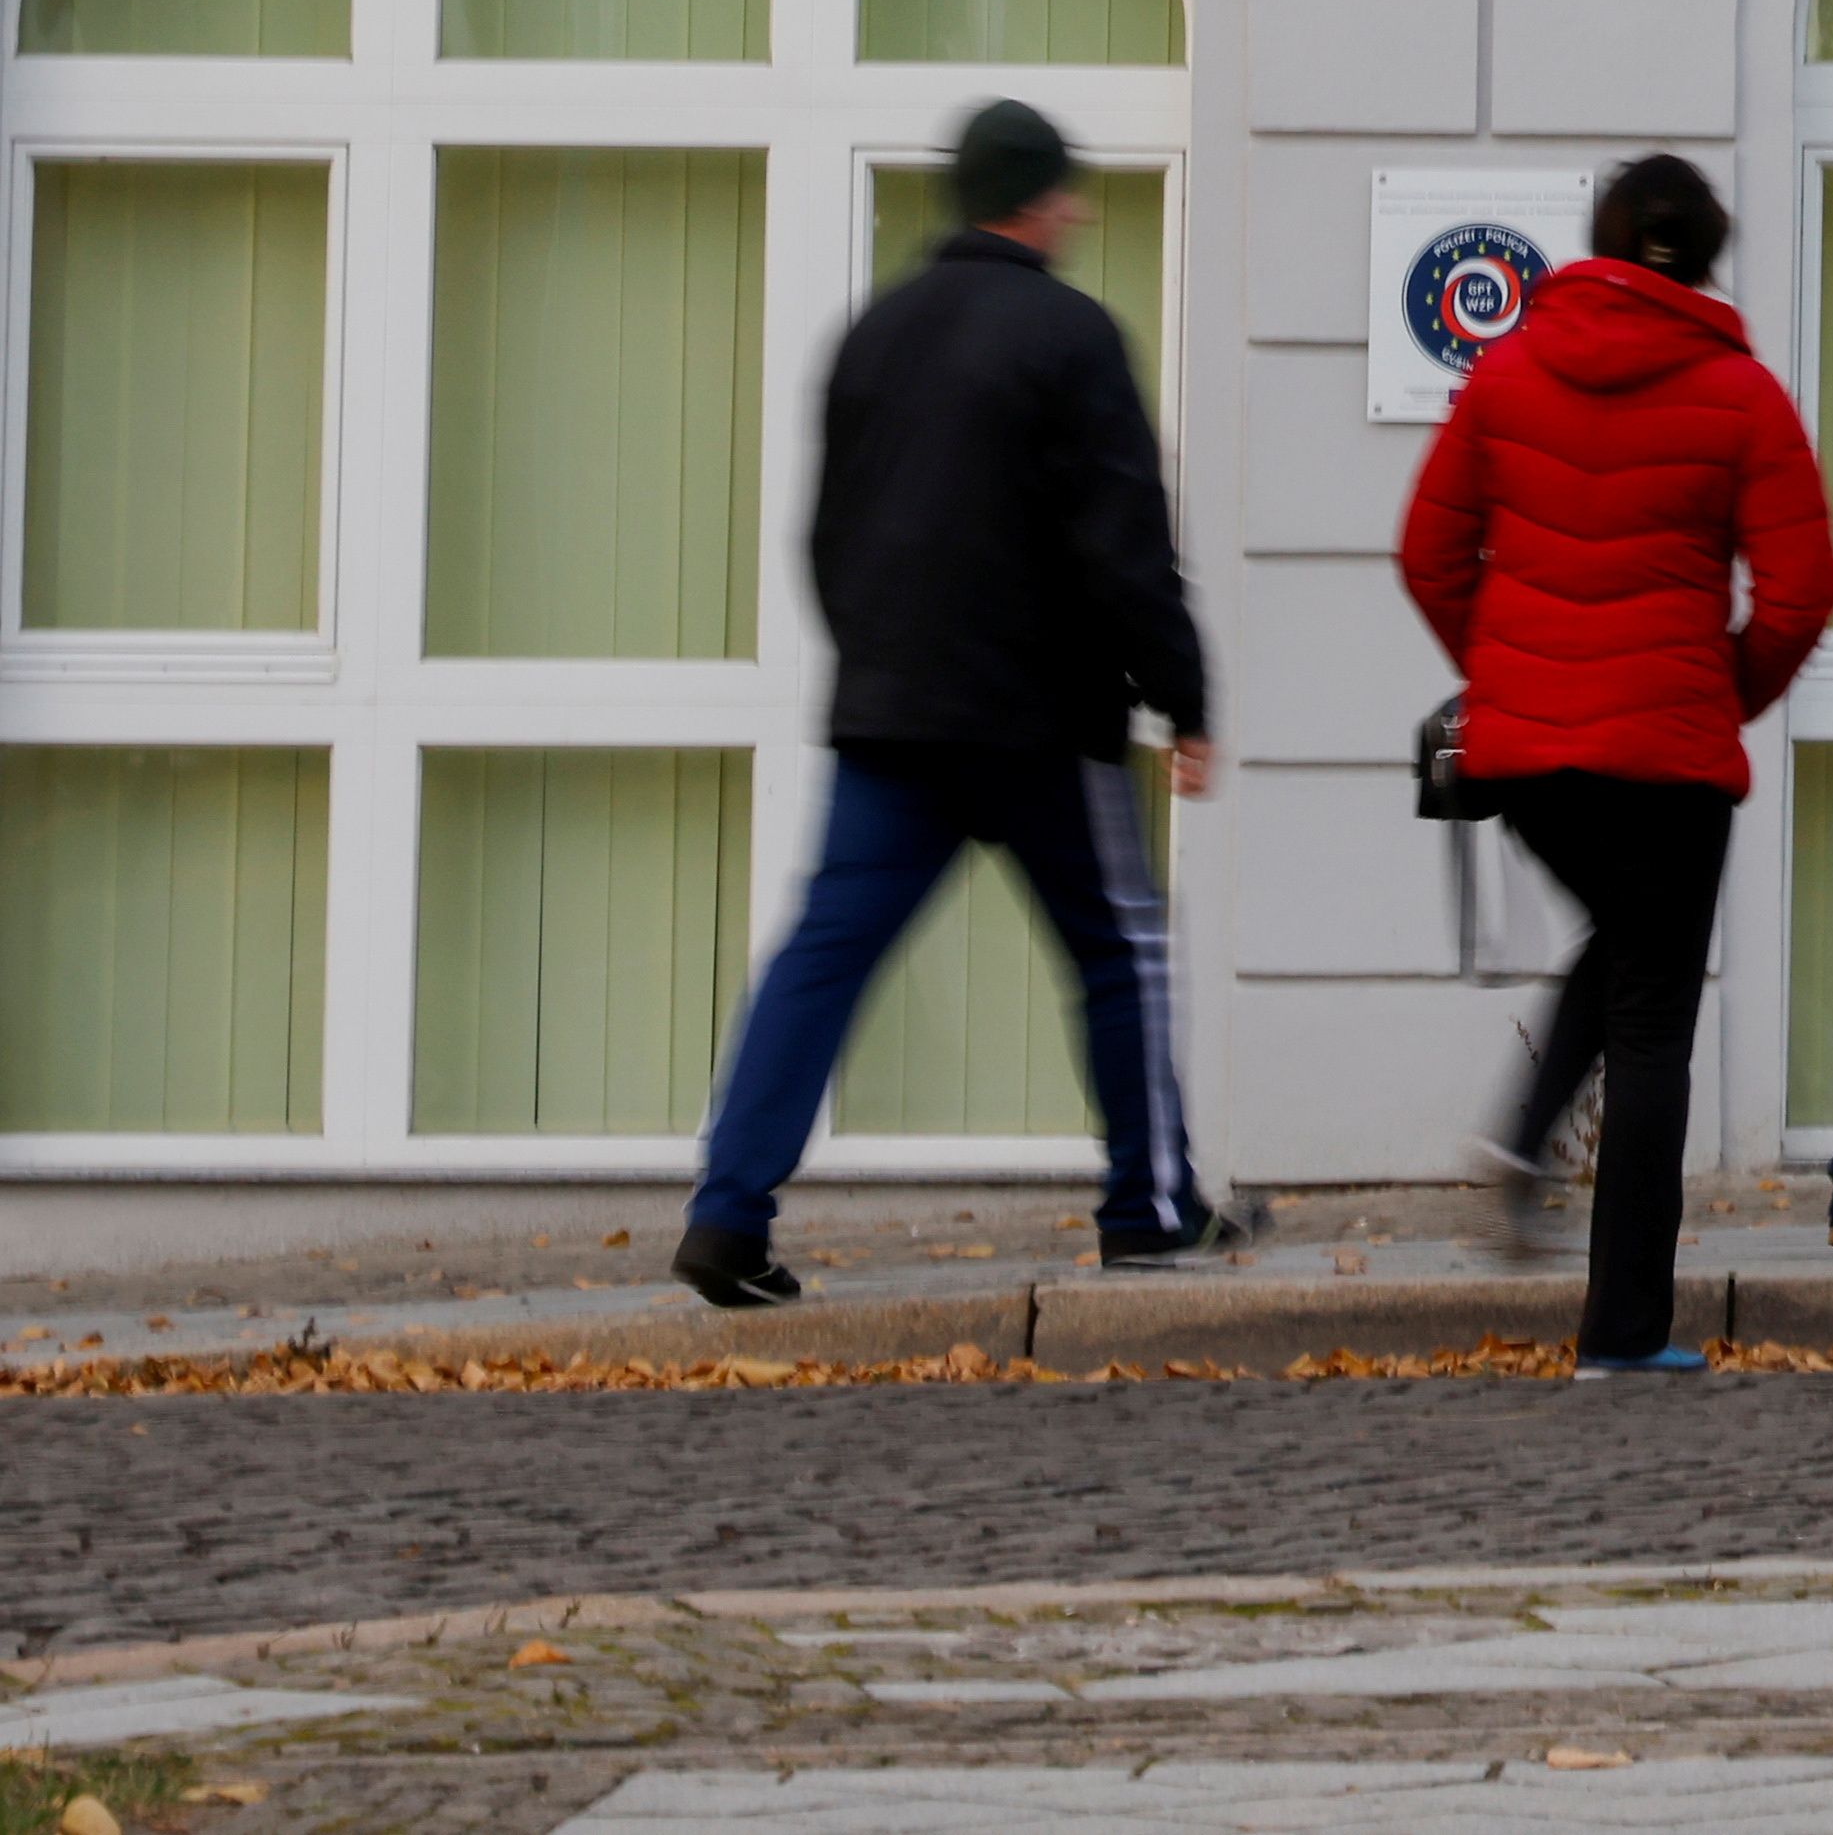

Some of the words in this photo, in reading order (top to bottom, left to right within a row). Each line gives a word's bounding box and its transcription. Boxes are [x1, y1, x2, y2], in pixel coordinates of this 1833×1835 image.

[1433, 228, 1475, 258] POLIZEI
[1486, 226, 1528, 258] POLICJA
[1467, 281, 1493, 297] GPT
[1465, 297, 1495, 314] WZP
